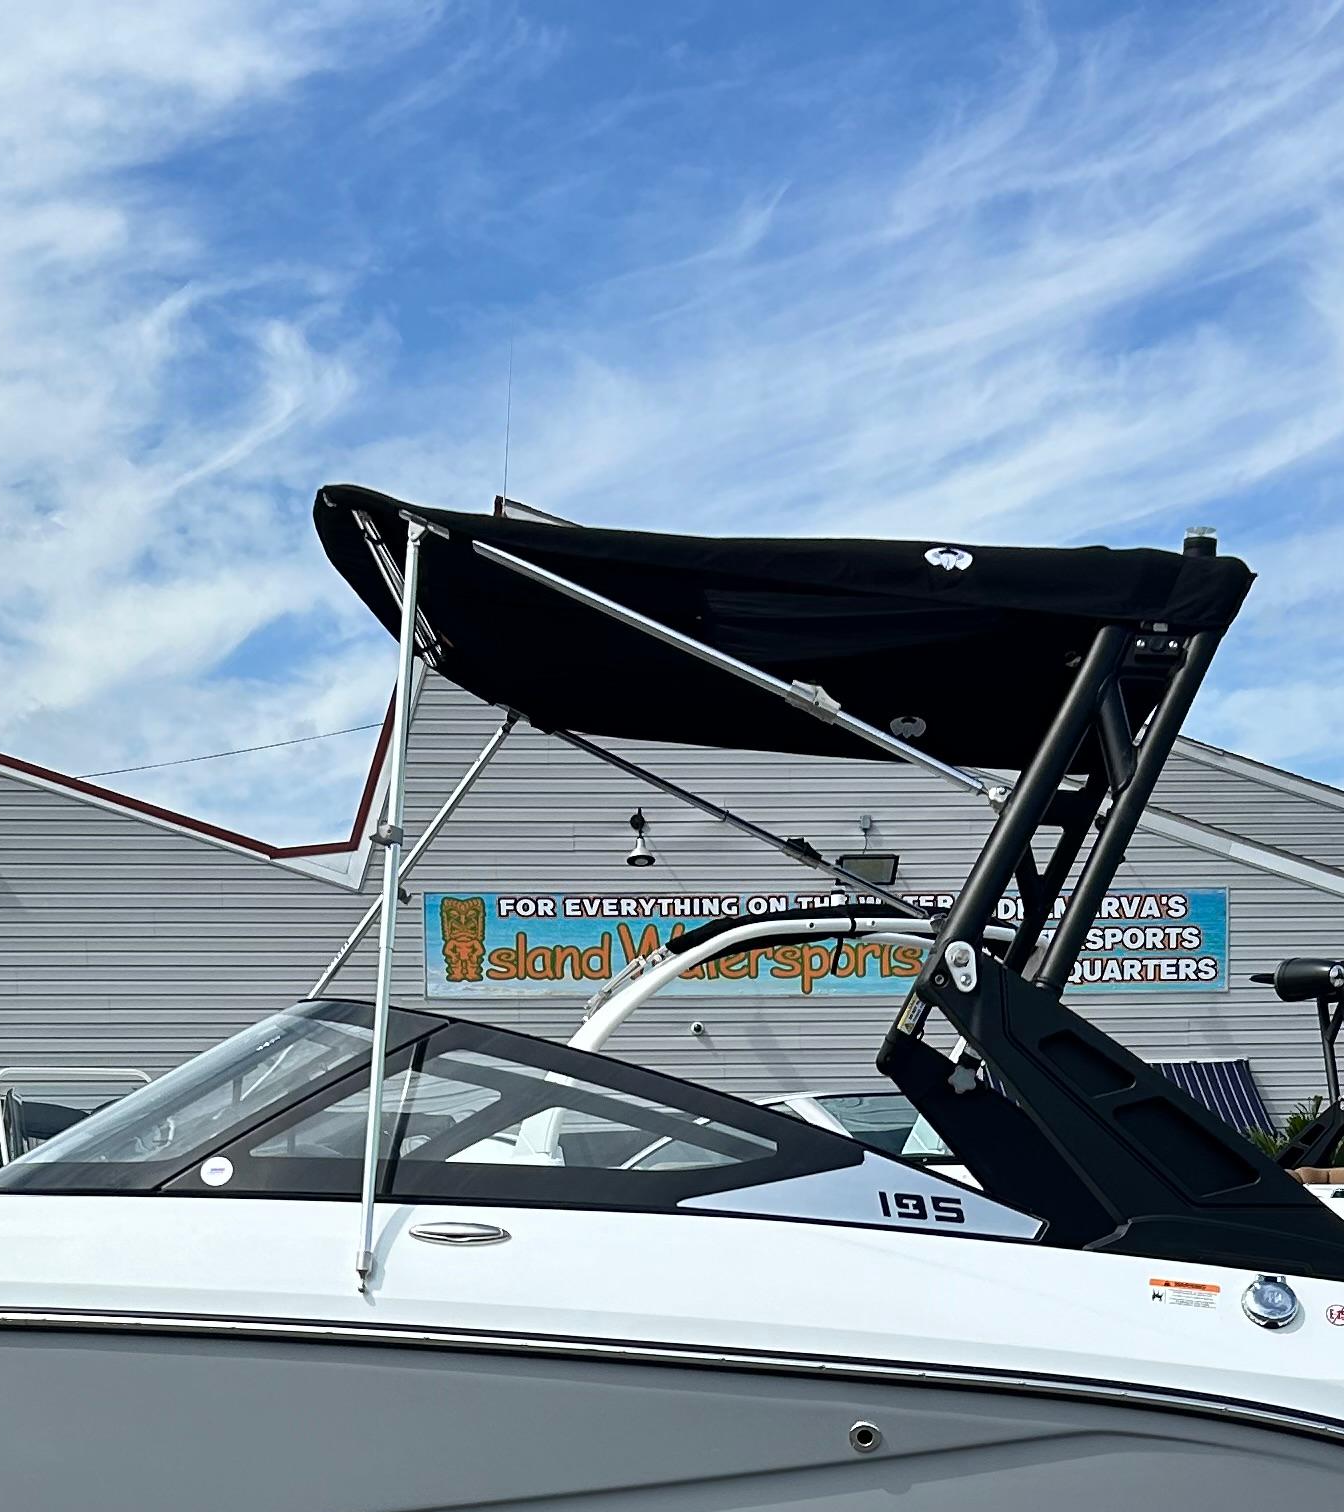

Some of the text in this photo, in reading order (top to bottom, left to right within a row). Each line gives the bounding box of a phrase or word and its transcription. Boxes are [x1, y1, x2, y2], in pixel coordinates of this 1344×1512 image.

[498, 897, 556, 917] FOR
[564, 897, 740, 917] EVERYTHING
[746, 897, 788, 915] ON
[797, 896, 846, 909] TH
[878, 1191, 965, 1224] 195
